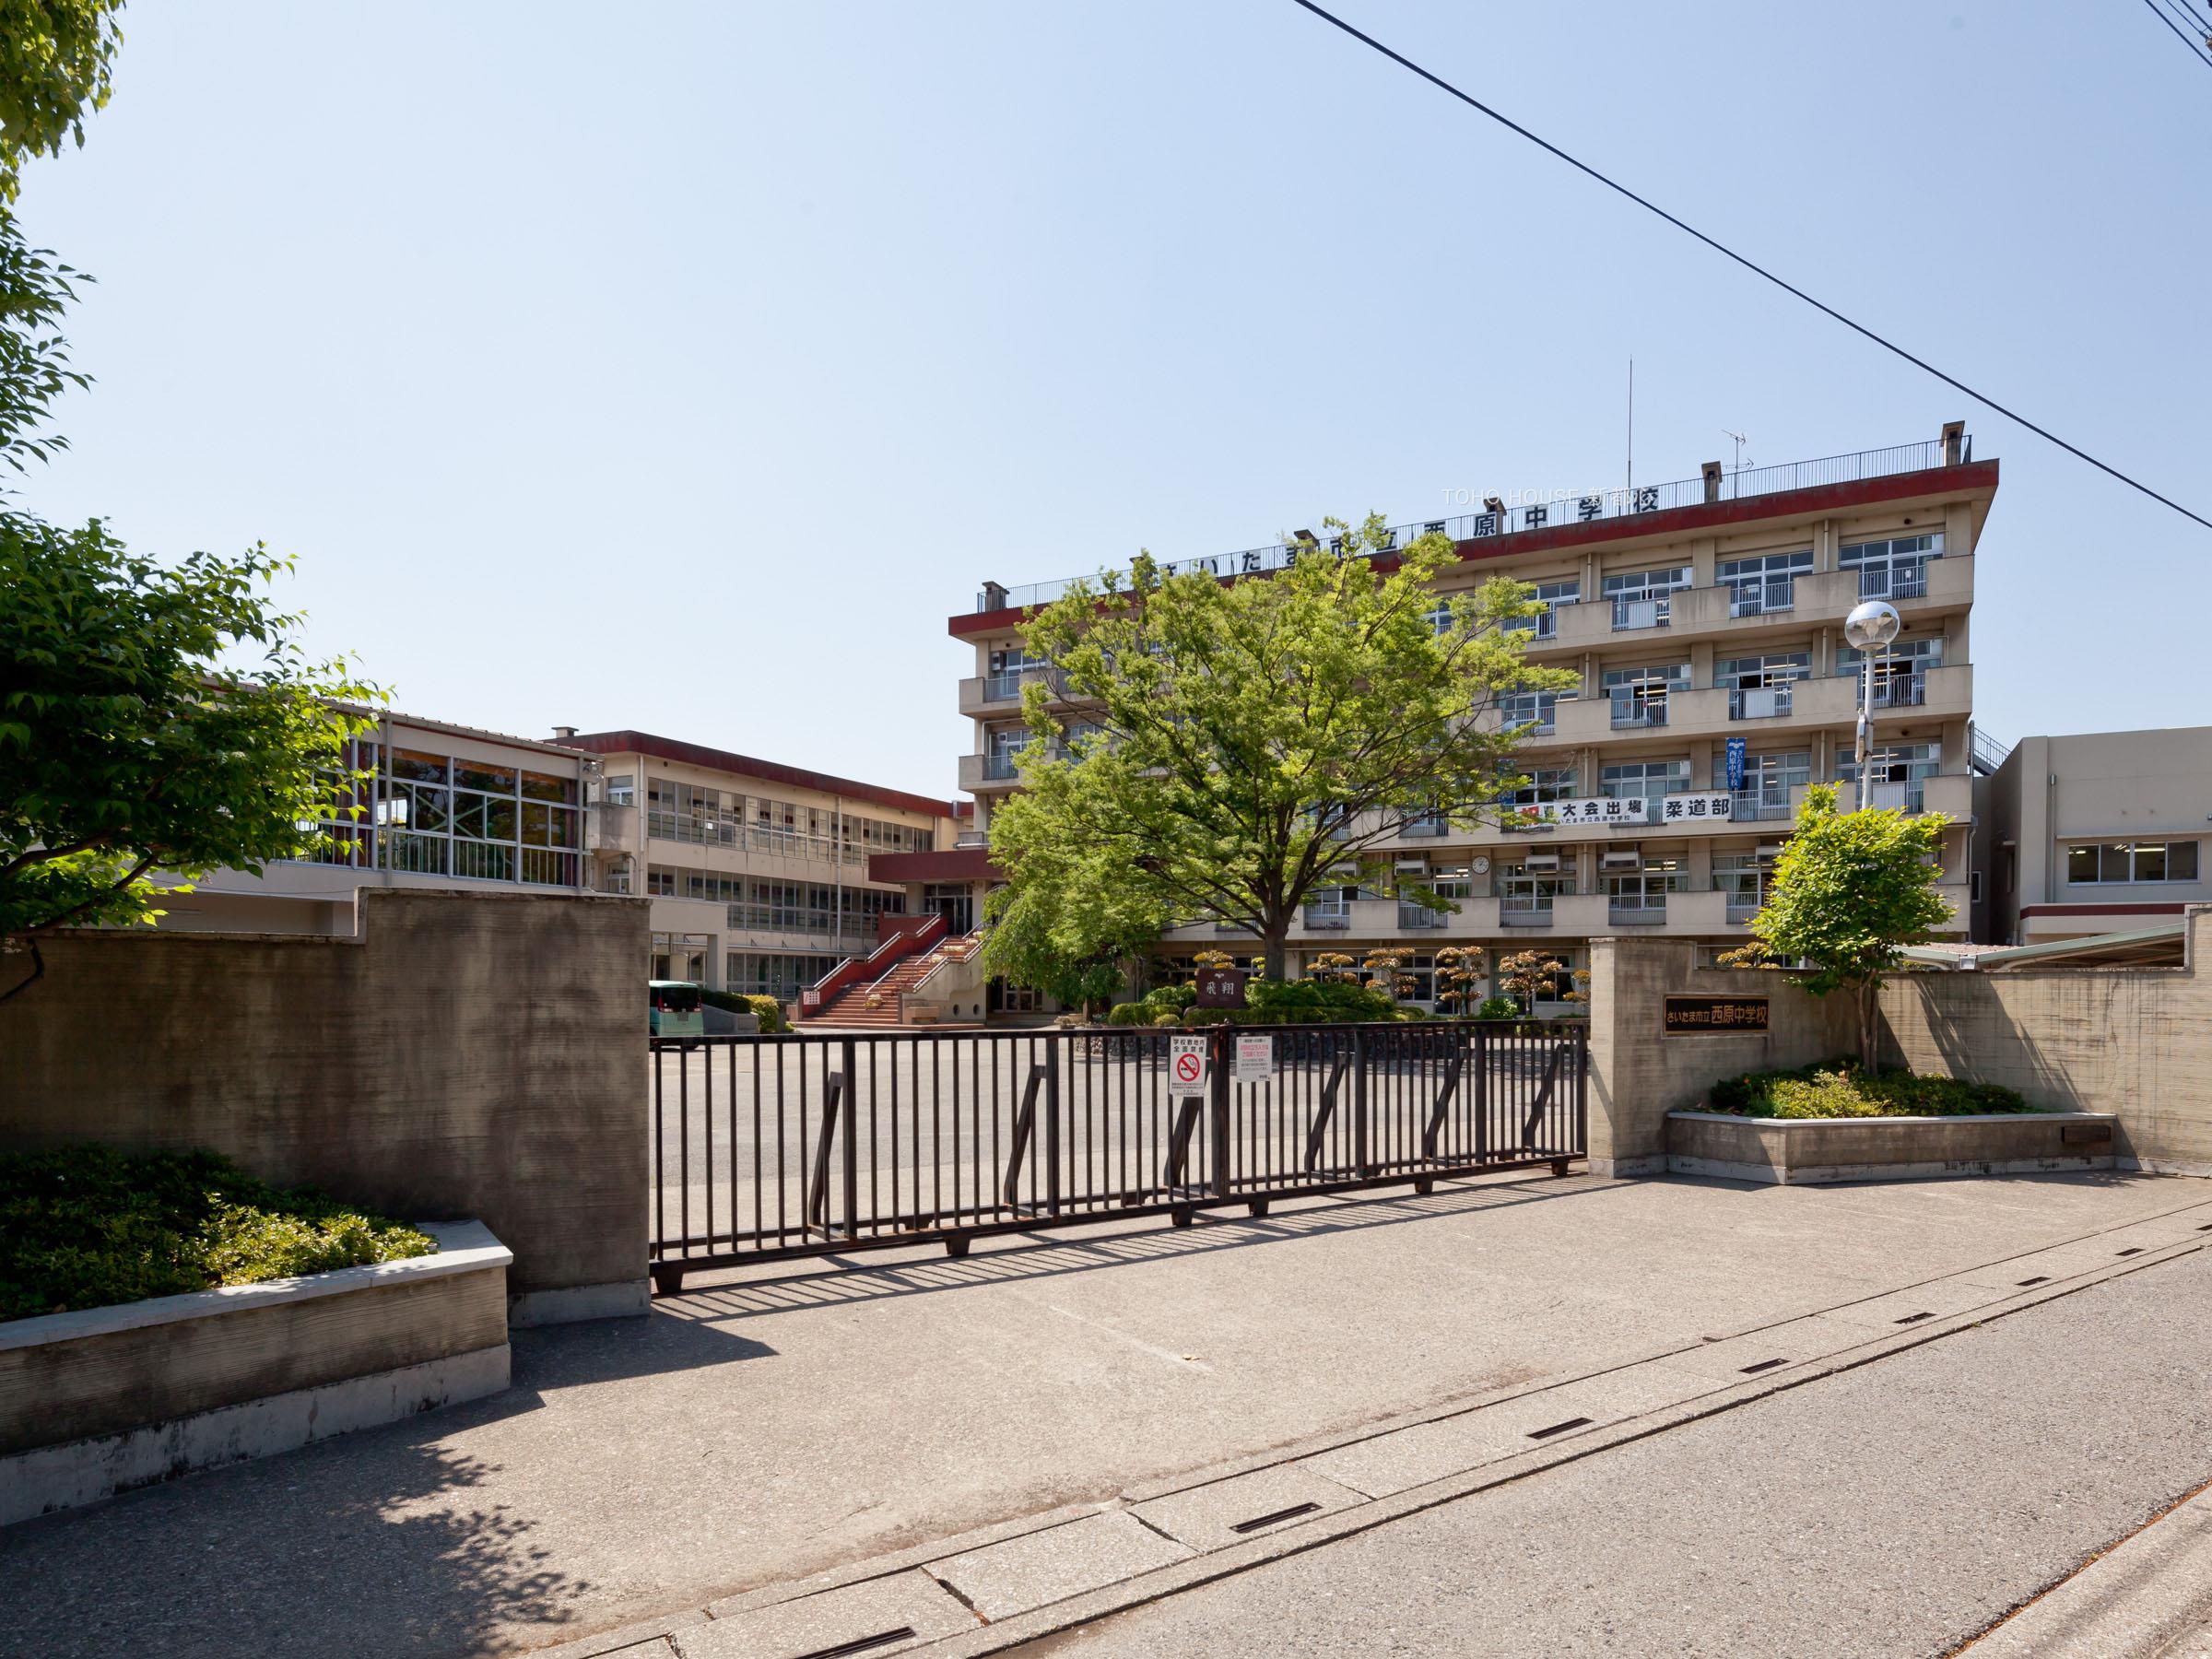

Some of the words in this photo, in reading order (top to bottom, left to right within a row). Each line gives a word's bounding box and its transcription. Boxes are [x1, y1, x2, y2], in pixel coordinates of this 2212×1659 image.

[1729, 750, 1738, 787] 西原中学校
[1666, 798, 1729, 818] 柔道部
[1558, 815, 1630, 824] いたま市立西原中学校
[1206, 981, 1234, 995] 飛翔
[1666, 1005, 1767, 1024] さいたま市立西原中学校
